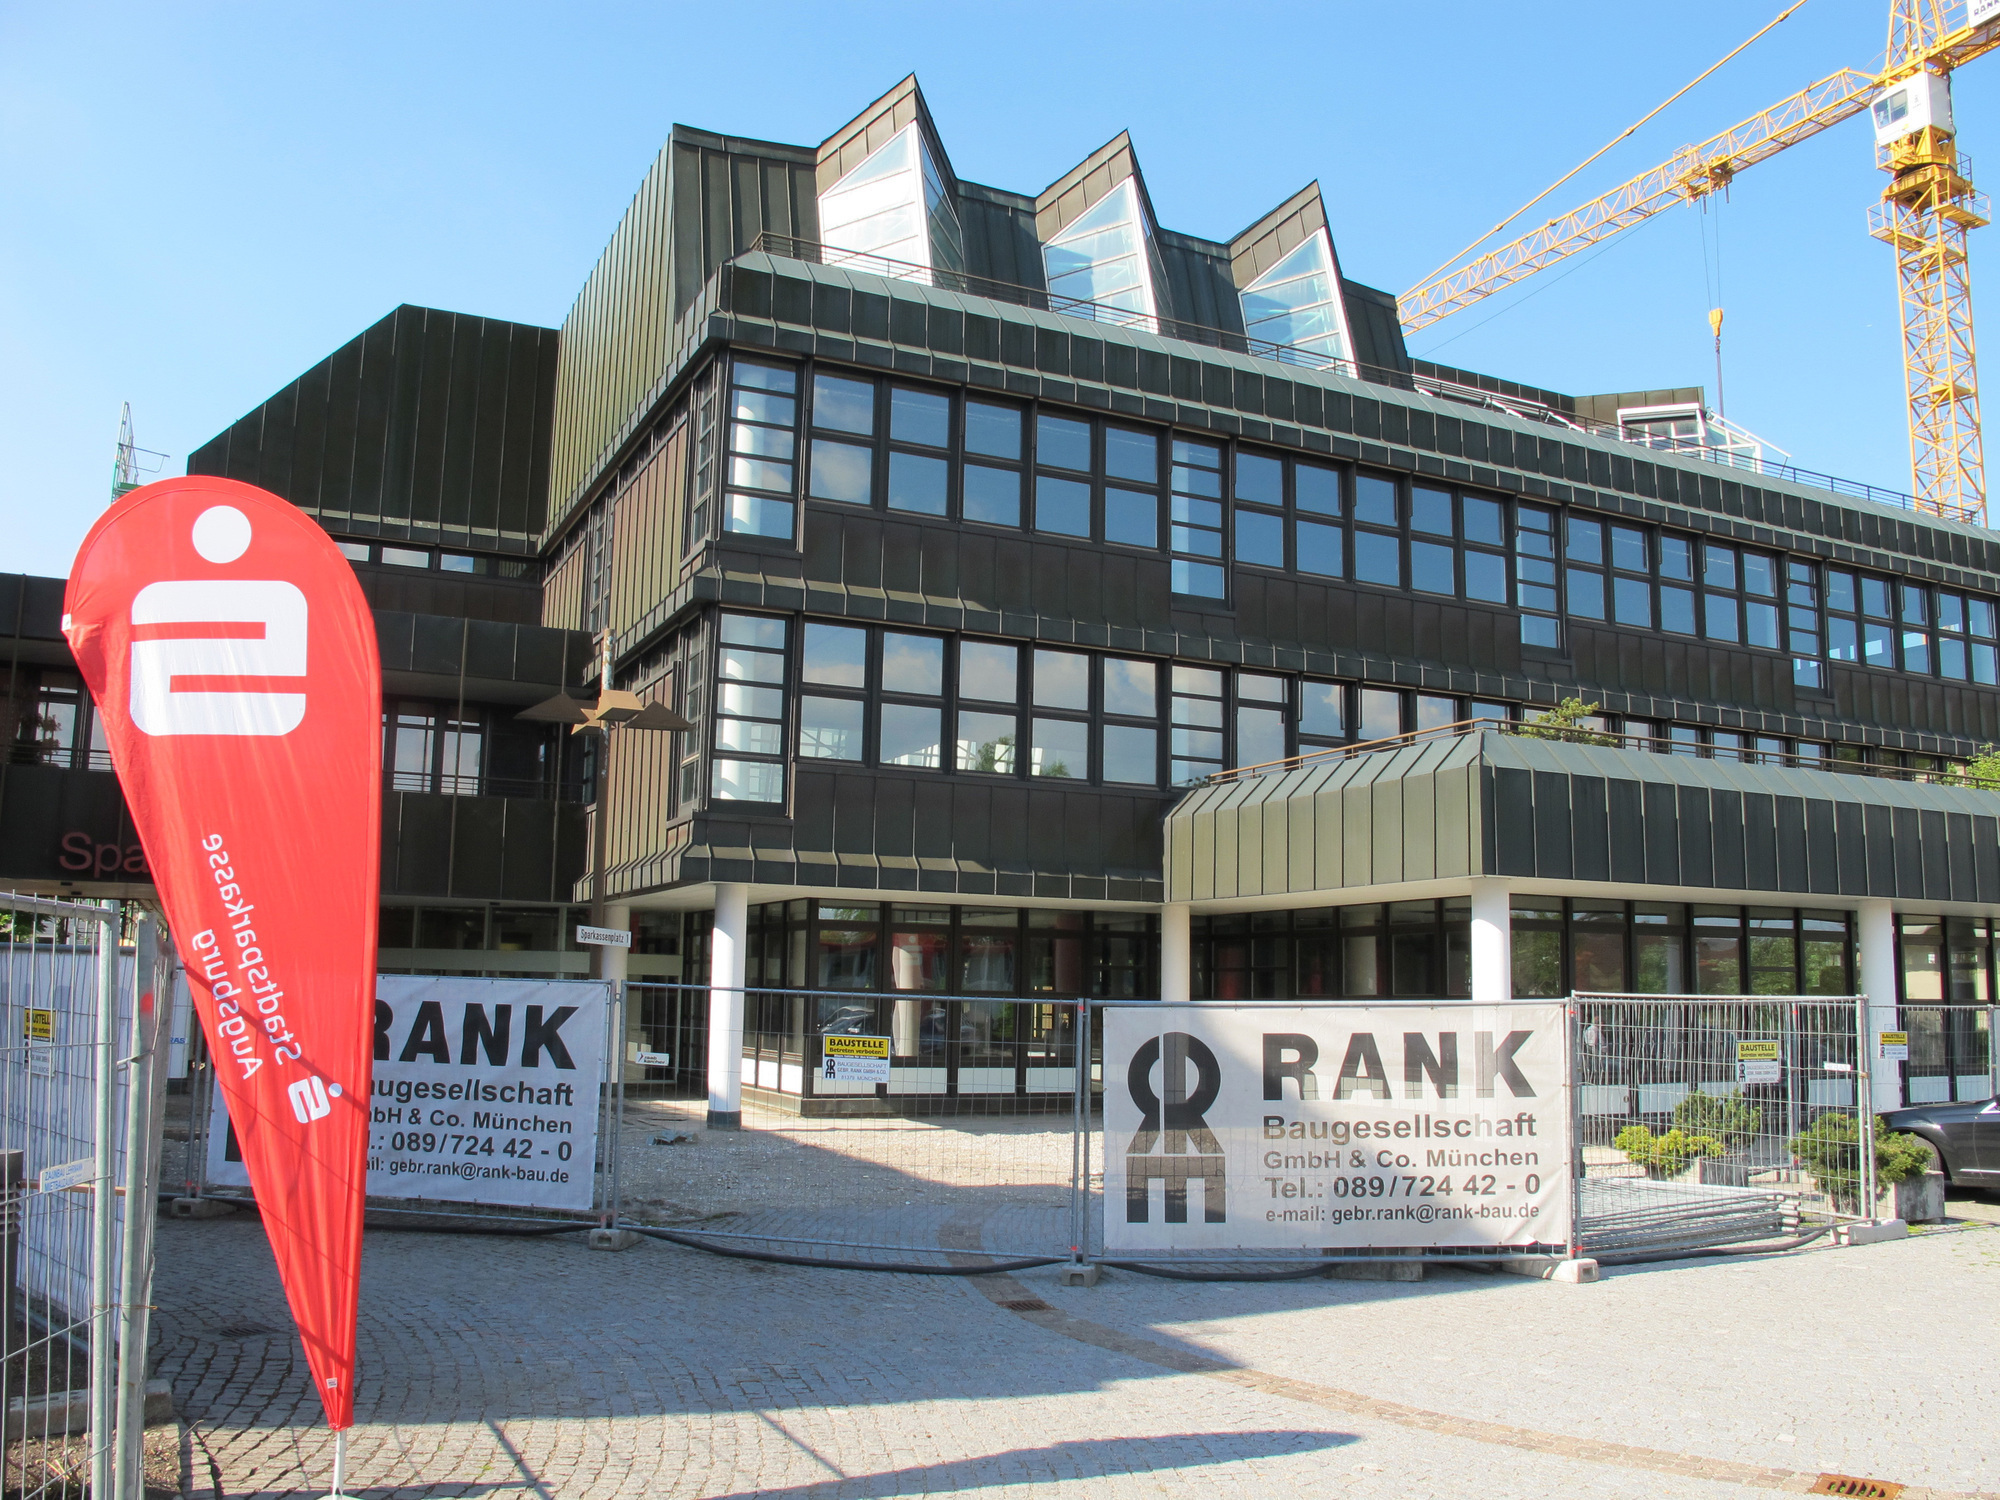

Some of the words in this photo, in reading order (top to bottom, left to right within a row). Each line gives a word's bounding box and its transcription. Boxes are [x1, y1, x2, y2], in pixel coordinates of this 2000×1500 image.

[580, 929, 624, 944] Sparkassenplatz
[830, 1038, 884, 1048] BAUSTELLE
[1262, 1030, 1538, 1100] RANK
[408, 1108, 421, 1125] &
[430, 1110, 465, 1128] Co.
[473, 1112, 572, 1134] München
[1262, 1112, 1538, 1146] Baugesellschaft
[392, 1132, 494, 1156] 089/724
[502, 1138, 533, 1158] 42
[558, 1141, 572, 1162] 0
[1263, 1150, 1341, 1169] GmbH
[1348, 1150, 1367, 1168] &
[1376, 1150, 1417, 1168] Co.
[1426, 1148, 1538, 1167] München
[389, 1158, 569, 1183] gebr.rank@rank-bau.de
[1264, 1176, 1324, 1199] Tel.:
[1333, 1174, 1453, 1198] 089/724
[1462, 1174, 1496, 1196] 42
[1525, 1174, 1541, 1194] 0
[1266, 1206, 1326, 1222] e-mail:
[1332, 1202, 1540, 1224] gebr.rank@rank-bau.de
